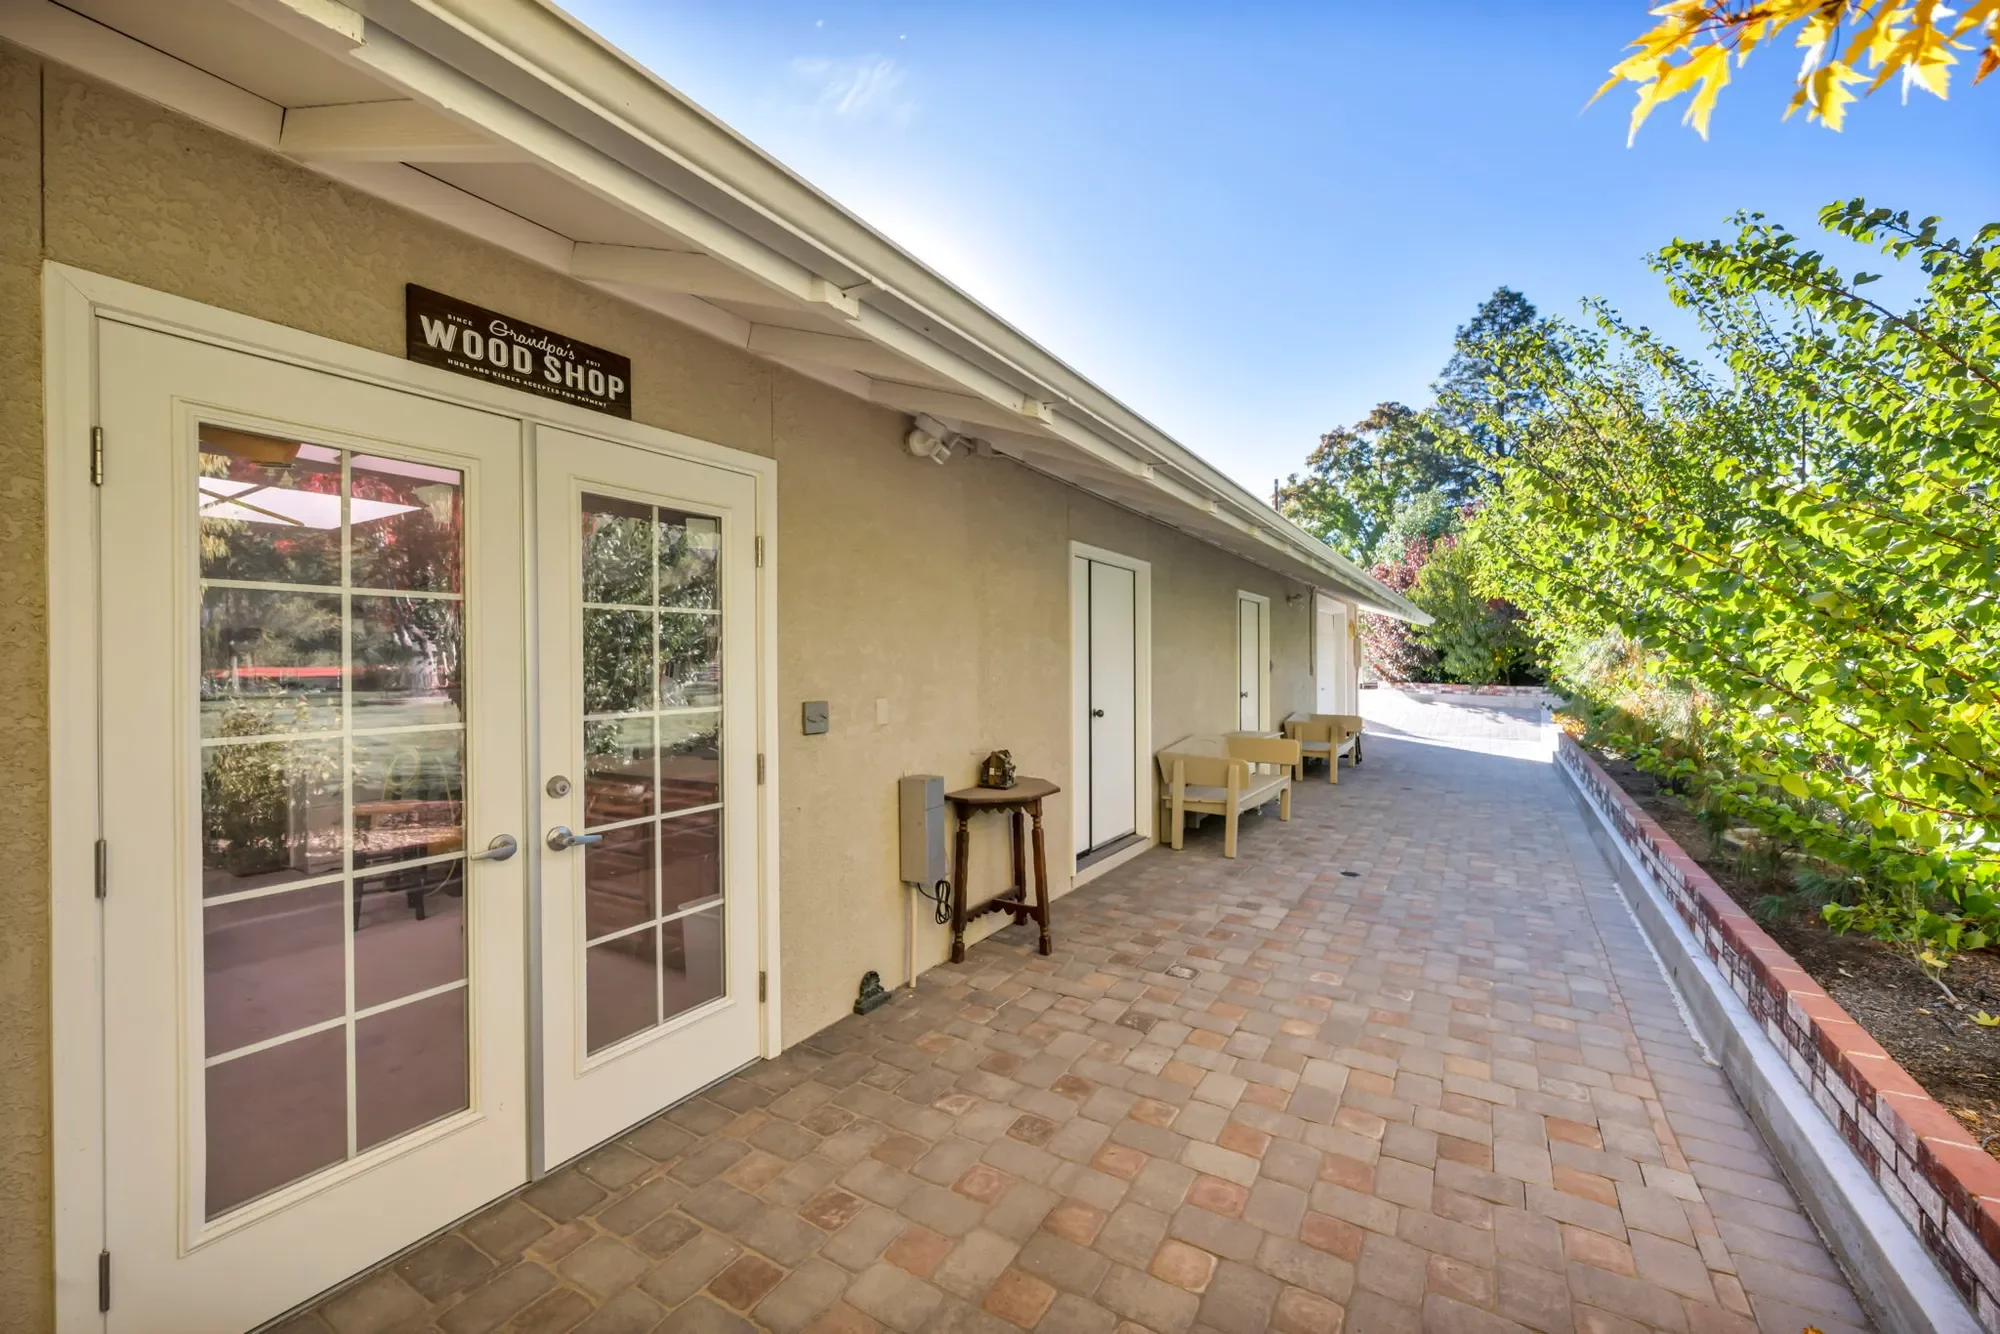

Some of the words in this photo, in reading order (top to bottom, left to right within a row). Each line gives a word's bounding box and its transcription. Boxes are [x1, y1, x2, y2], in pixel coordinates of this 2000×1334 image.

[447, 313, 473, 327] SINCE
[489, 319, 576, 360] Grandpa's
[420, 314, 533, 375] WOOD
[544, 355, 625, 400] SHOP
[447, 358, 470, 370] HUGS
[473, 366, 490, 375] AND
[492, 371, 521, 384] KISSES
[523, 380, 560, 395] ACCEPTED
[562, 391, 575, 399] FOR
[577, 395, 607, 408] PAYMENT
